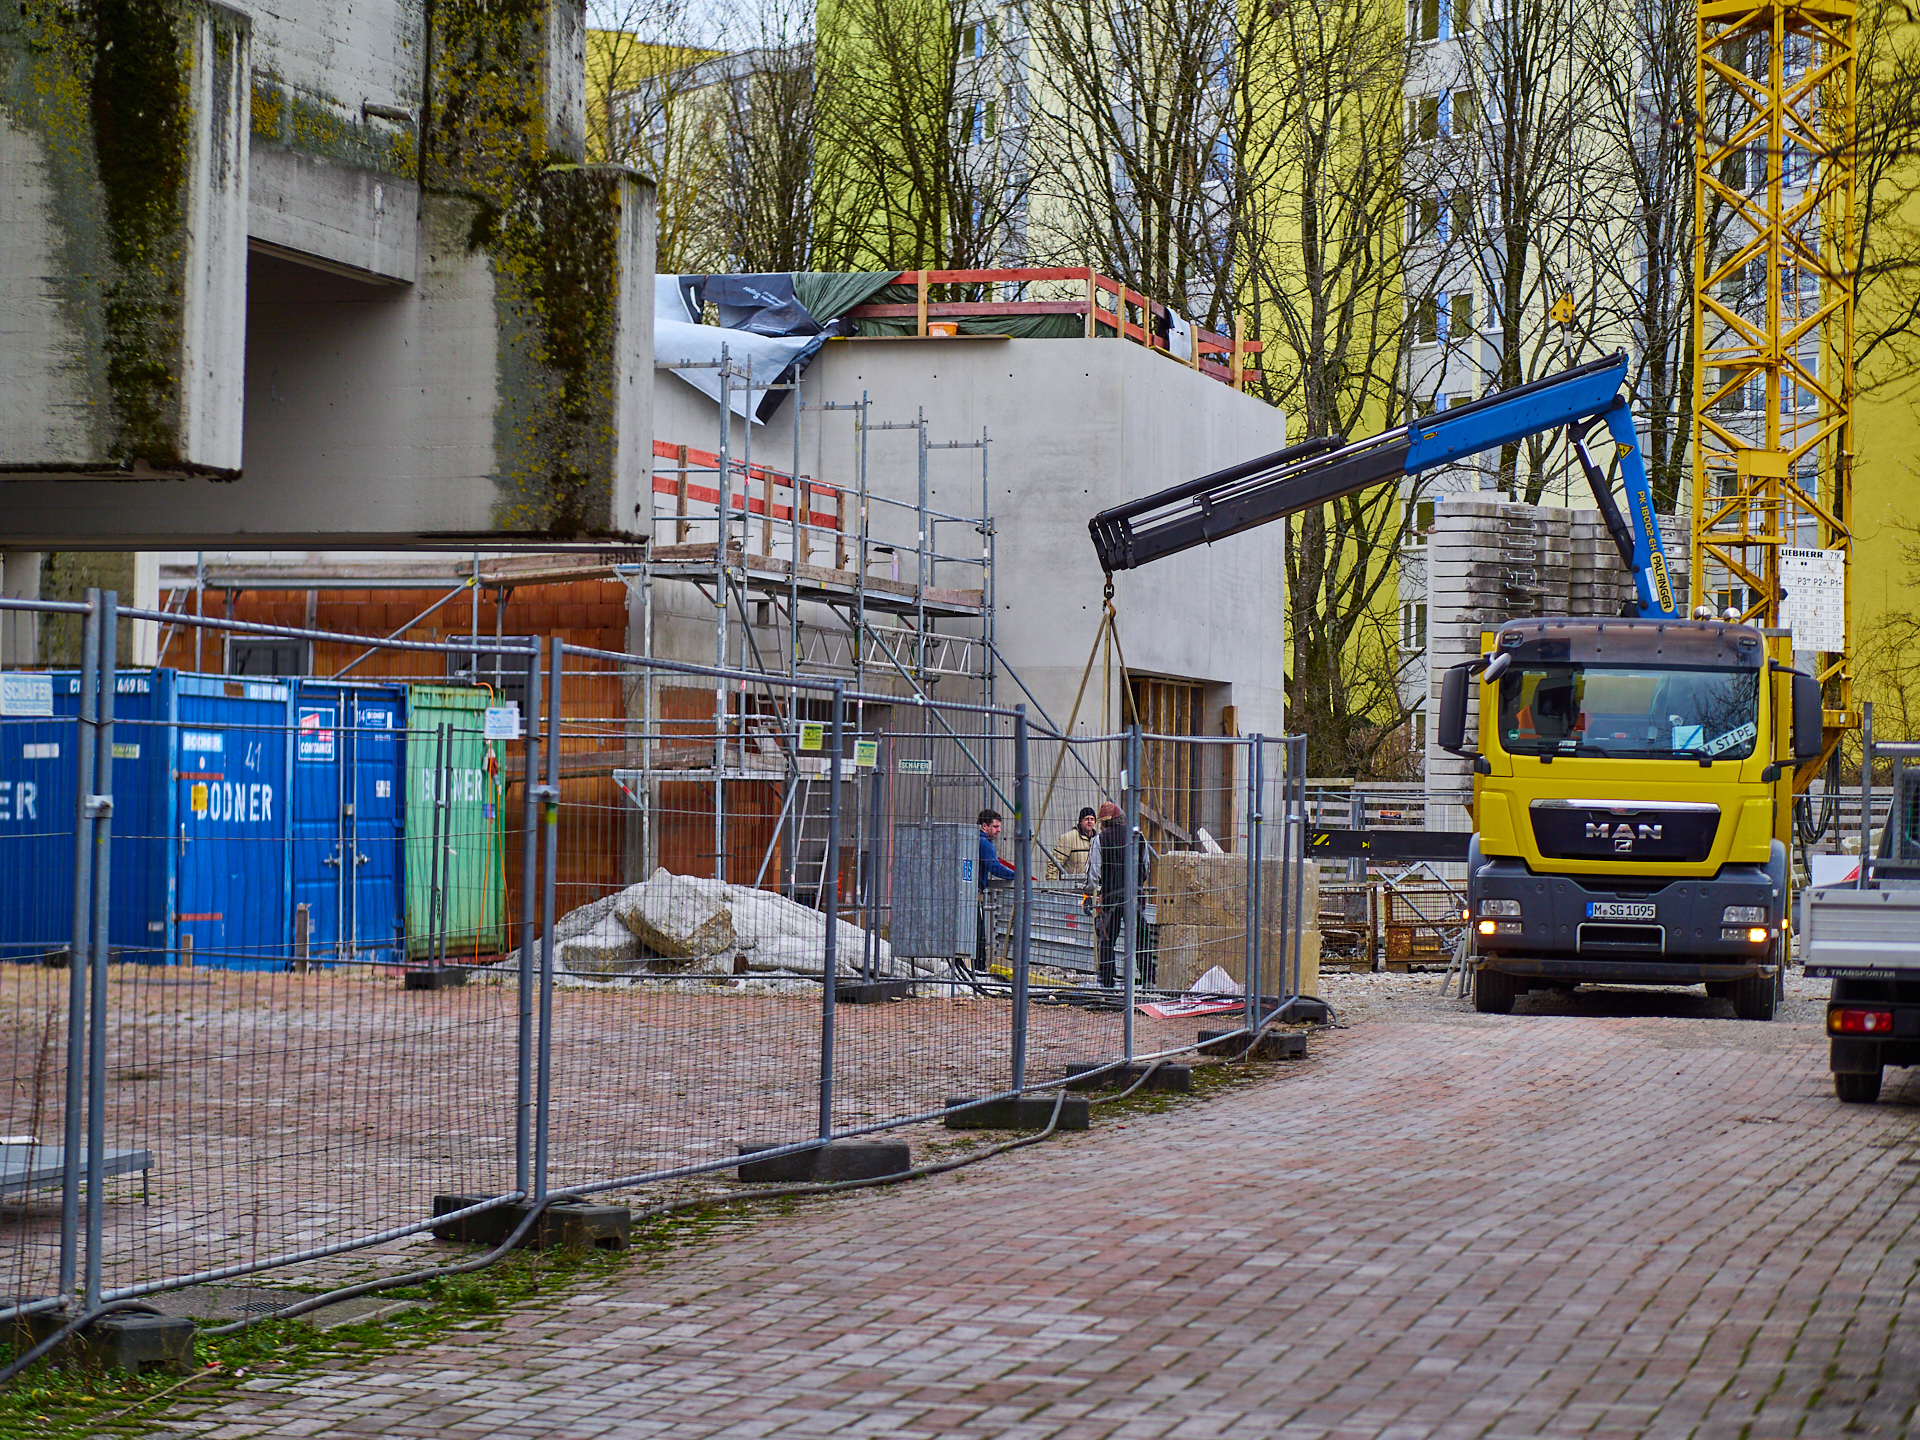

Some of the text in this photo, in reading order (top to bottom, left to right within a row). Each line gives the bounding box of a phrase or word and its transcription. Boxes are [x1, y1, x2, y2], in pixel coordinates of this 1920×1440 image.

[1637, 490, 1647, 504] PK
[1781, 549, 1824, 559] LIEBHERR
[1652, 555, 1673, 611] PALFINGER
[1716, 725, 1754, 749] STIPE
[1585, 822, 1663, 840] MAN
[1594, 904, 1655, 917] M SG 1095
[1830, 968, 1896, 978] TRANSPORTER
